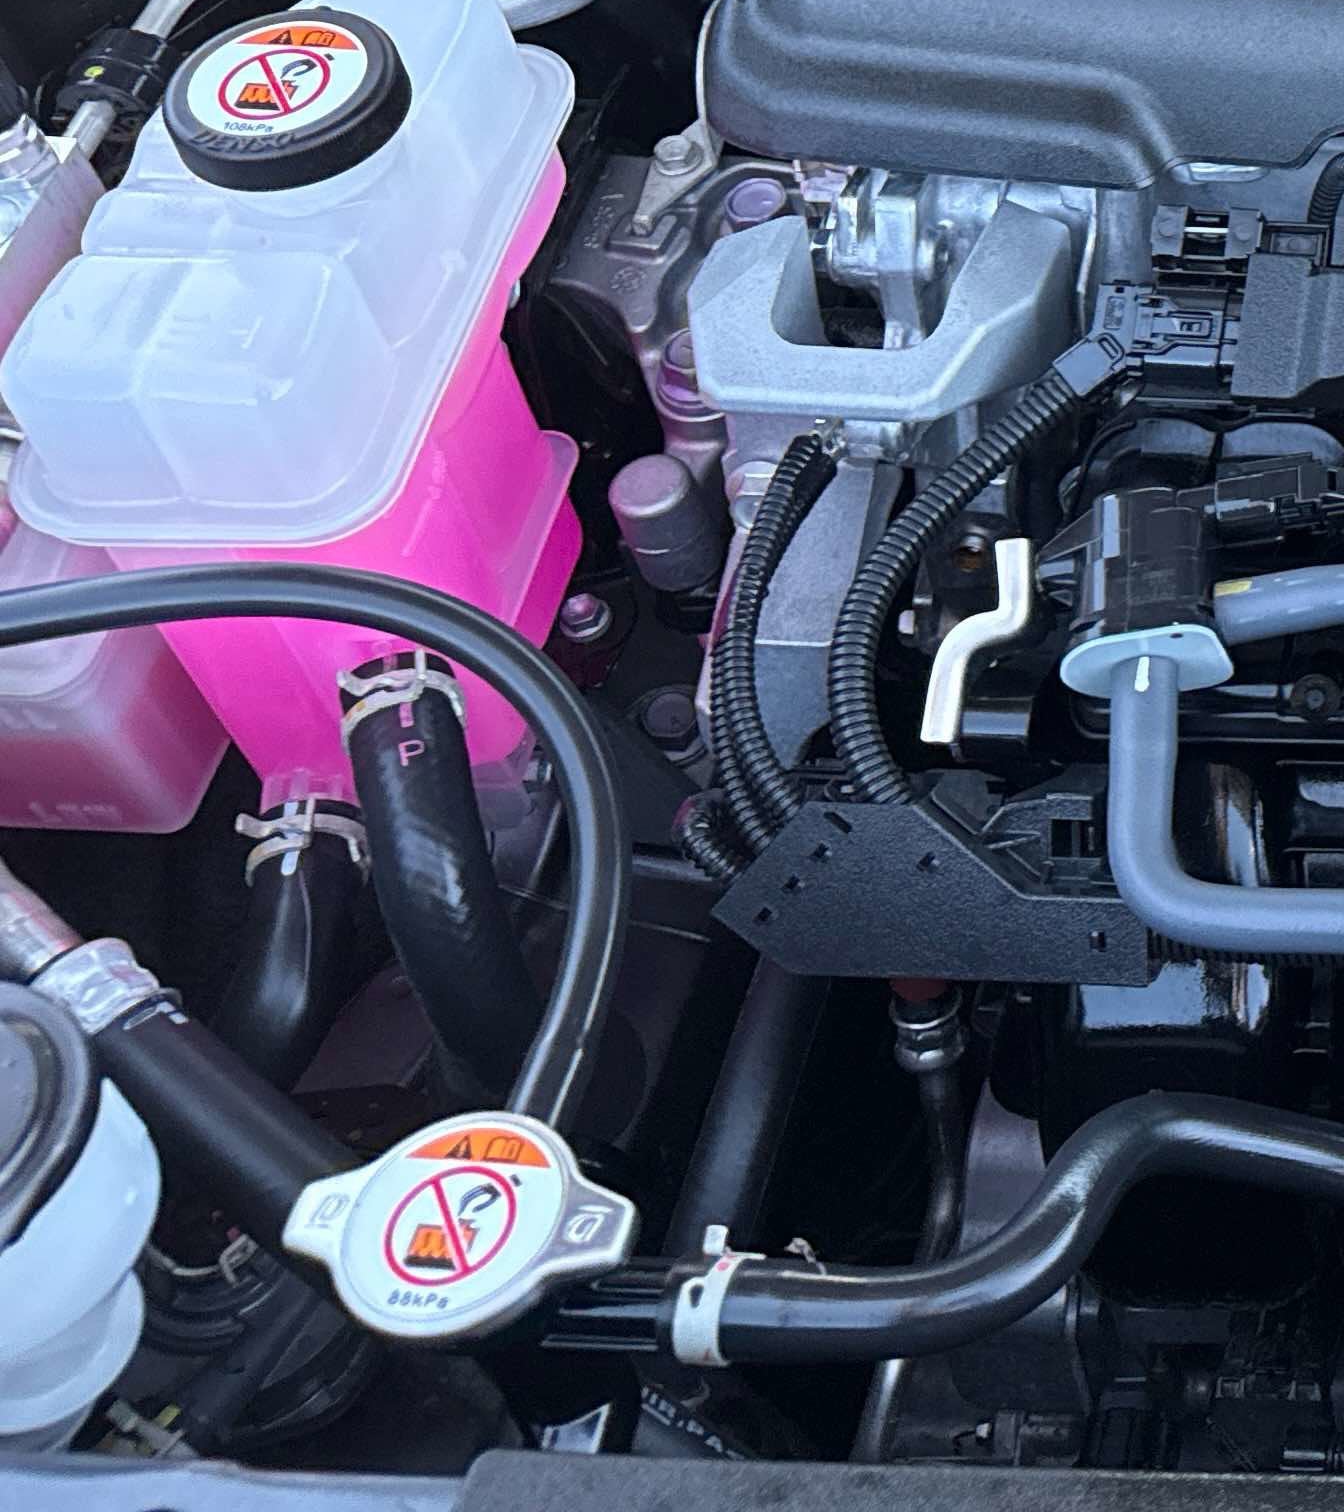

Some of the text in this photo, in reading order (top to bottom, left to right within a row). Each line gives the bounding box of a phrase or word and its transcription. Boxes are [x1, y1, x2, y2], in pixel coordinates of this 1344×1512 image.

[223, 121, 275, 133] 108kPa
[398, 739, 425, 767] P
[387, 1291, 449, 1309] 88kPa
